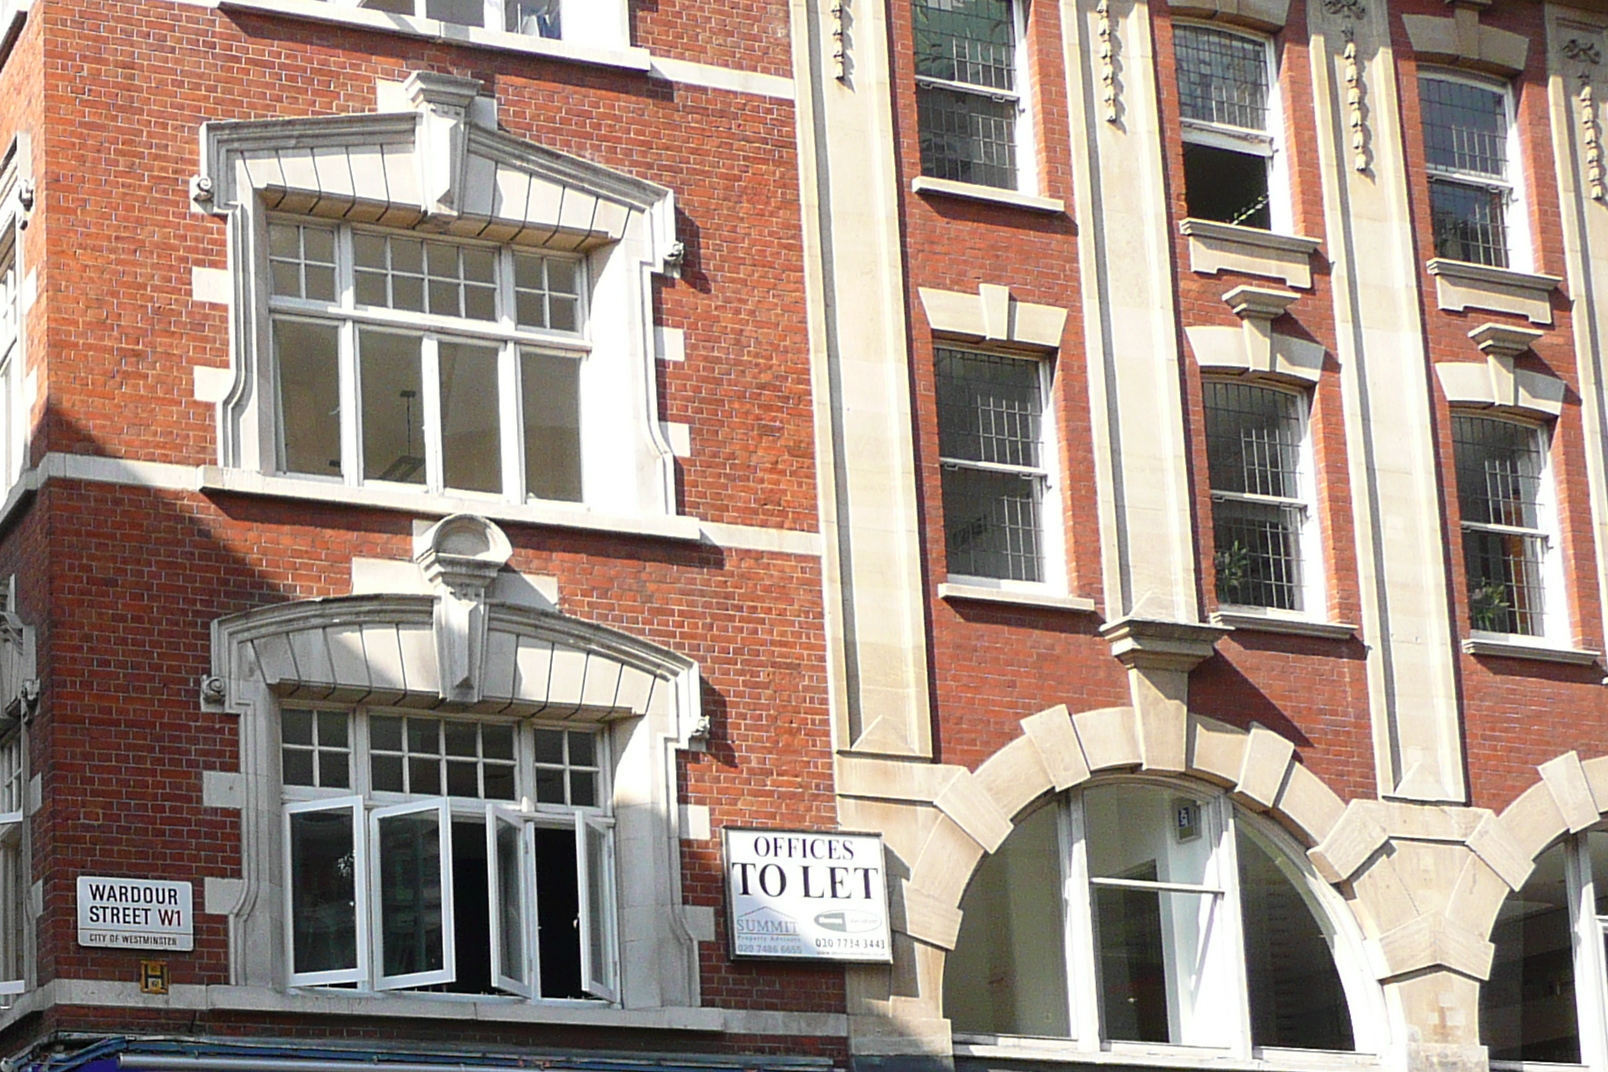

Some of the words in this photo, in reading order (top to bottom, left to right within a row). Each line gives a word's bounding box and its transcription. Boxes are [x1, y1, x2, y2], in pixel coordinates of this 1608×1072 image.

[754, 836, 855, 860] OFFICES
[732, 862, 787, 898] TO
[799, 865, 879, 900] LET
[89, 884, 178, 905] WARDOUR
[89, 905, 151, 925] STREET
[158, 908, 181, 926] W1
[736, 918, 798, 933] SUMMIT
[89, 933, 107, 943] CITY
[110, 934, 120, 943] OF
[122, 935, 177, 946] WESTMINSTER
